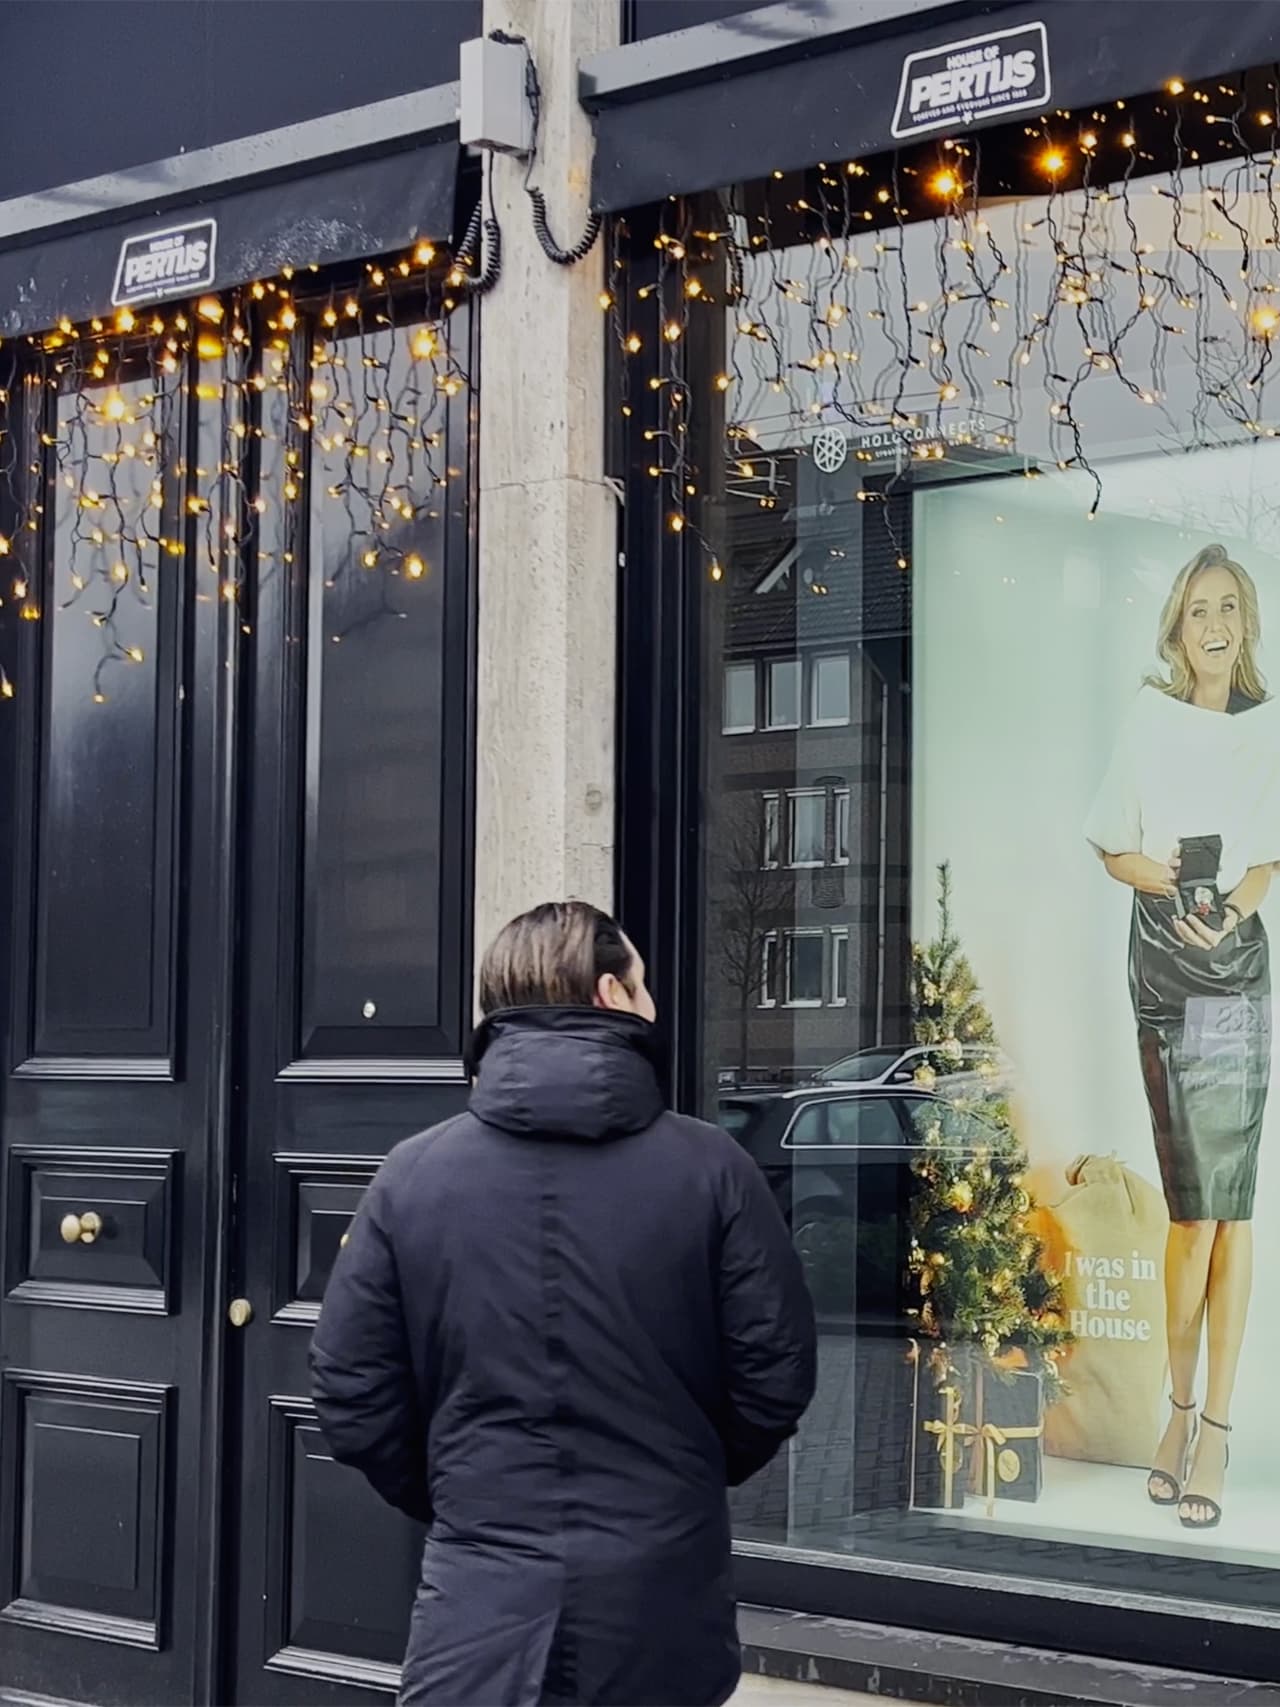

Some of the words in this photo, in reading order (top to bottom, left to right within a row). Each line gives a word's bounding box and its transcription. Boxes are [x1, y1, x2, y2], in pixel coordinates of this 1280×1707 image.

[947, 49, 983, 70] HOUSE
[984, 45, 1000, 61] OF
[909, 50, 1036, 113] PERTUS
[124, 240, 208, 287] PERTUS
[861, 417, 986, 449] HOLOCONNECTS
[1075, 1256, 1126, 1279] was
[1131, 1249, 1157, 1281] in
[1086, 1279, 1131, 1312] the
[1069, 1309, 1151, 1341] House
